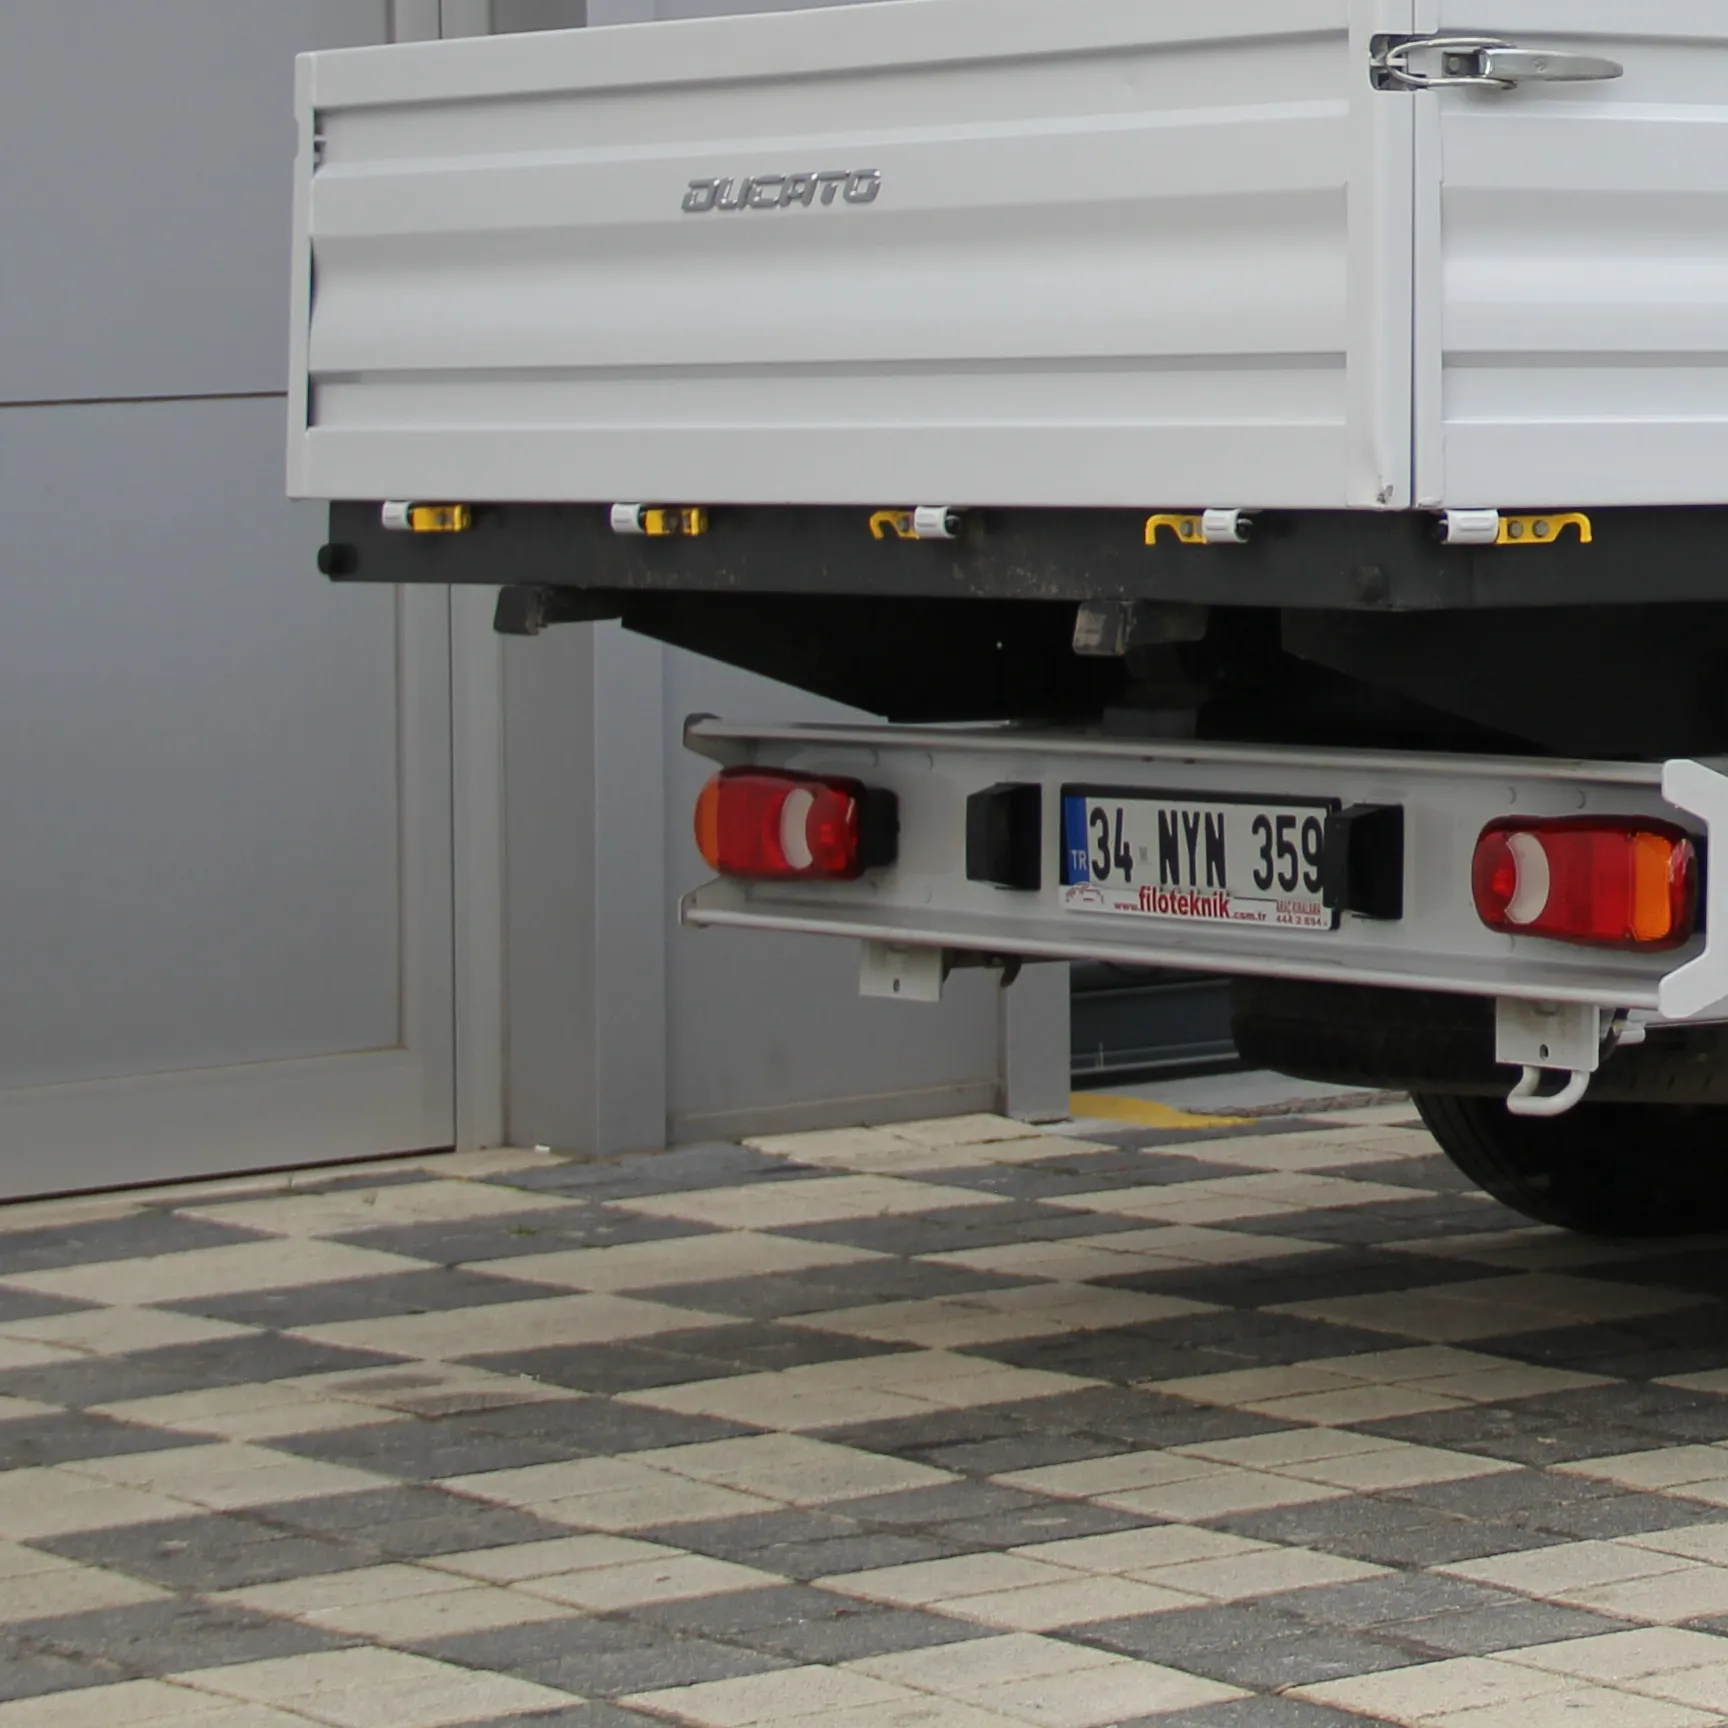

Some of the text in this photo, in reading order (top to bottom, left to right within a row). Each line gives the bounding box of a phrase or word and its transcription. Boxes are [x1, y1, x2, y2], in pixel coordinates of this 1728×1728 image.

[681, 169, 881, 213] DUCATO
[1071, 850, 1087, 870] TR
[1090, 806, 1323, 893] 34 NYN 359
